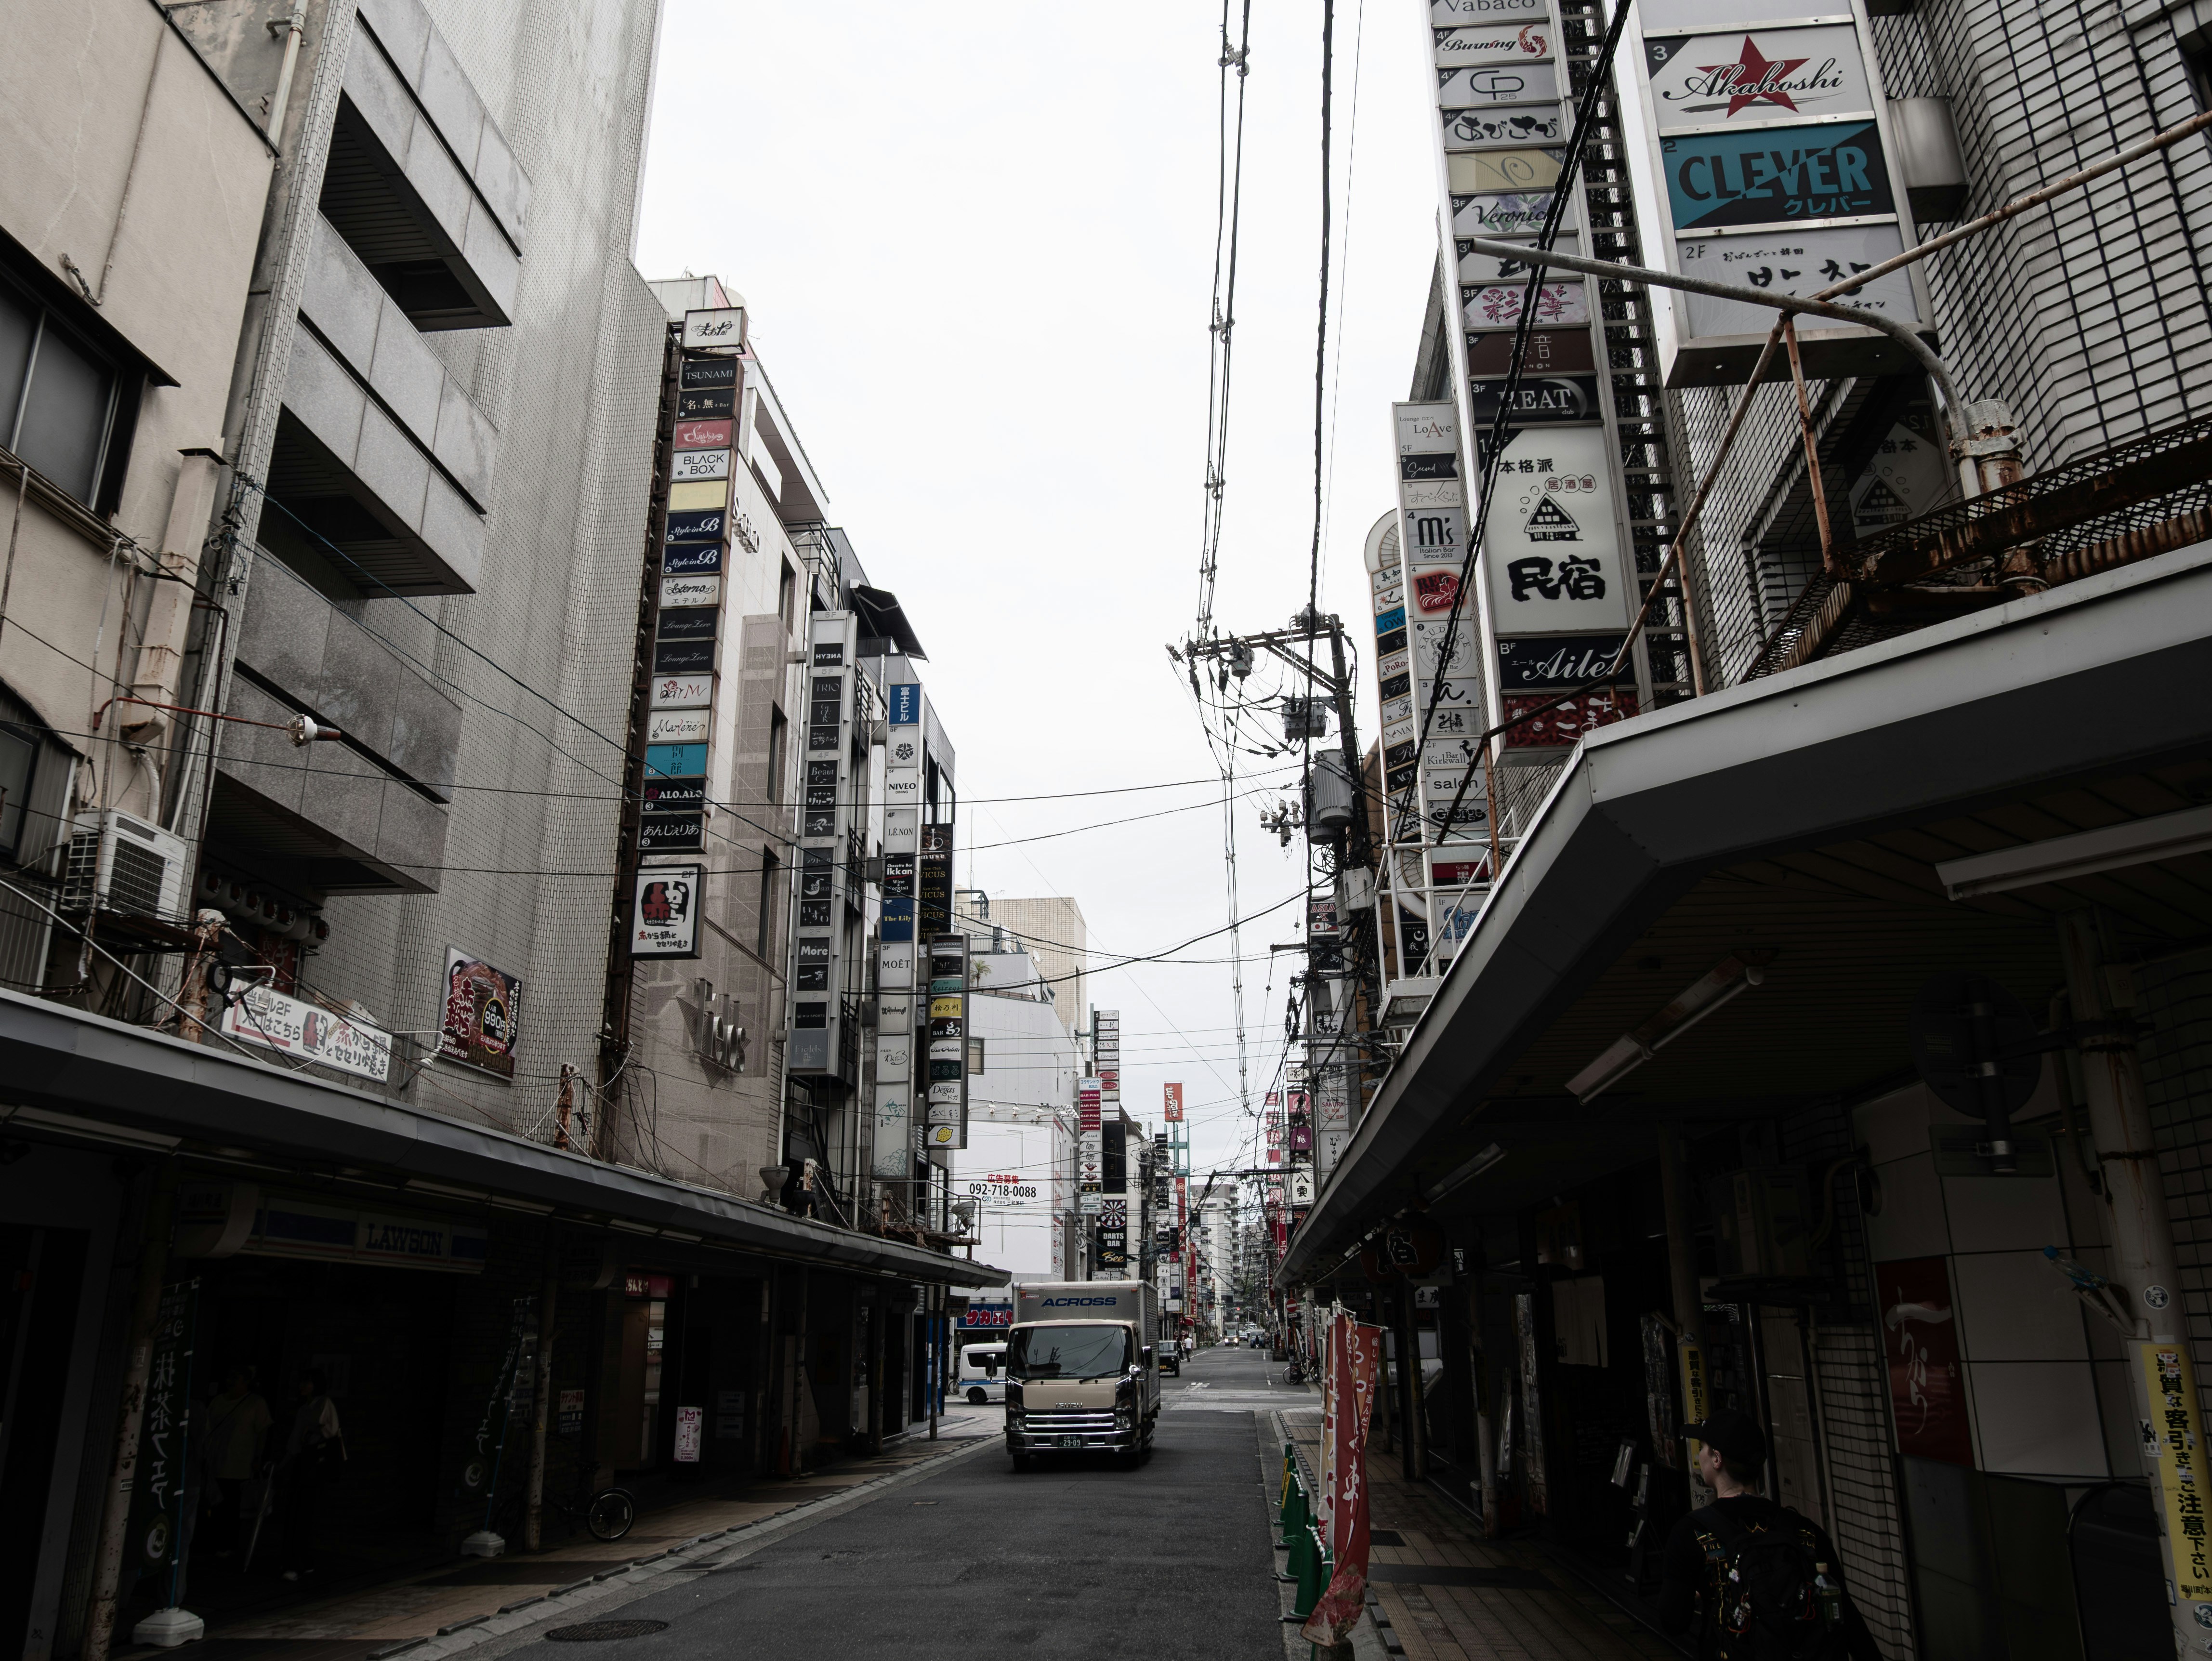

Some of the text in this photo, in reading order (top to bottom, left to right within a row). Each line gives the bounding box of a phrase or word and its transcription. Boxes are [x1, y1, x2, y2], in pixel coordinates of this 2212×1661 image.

[1437, 31, 1450, 40] 4F
[1442, 39, 1516, 52] Burning
[1441, 71, 1454, 79] 4F
[1662, 58, 1843, 100] Akahoshi
[1678, 146, 1873, 201] CLEVER
[1453, 199, 1466, 208] 3F
[1784, 198, 1871, 215] クレバー
[1472, 202, 1557, 224] Veronic
[1686, 245, 1706, 259] 2F
[685, 369, 734, 380] TSUNAMI
[1473, 384, 1486, 393] 3F
[683, 454, 724, 465] BLACK
[690, 464, 716, 475] BOX
[1407, 462, 1436, 477] Second
[1500, 459, 1554, 474] 本格派
[1547, 479, 1594, 490] 居酒屋
[672, 526, 691, 536] Style
[700, 517, 720, 532] B
[669, 559, 688, 567] Style
[698, 549, 718, 564] B
[1507, 554, 1606, 602] 民宿
[1382, 611, 1398, 620] Lounge
[663, 620, 711, 631] Lounge Zero
[1500, 643, 1516, 654] BF
[660, 653, 709, 664] Lounge Zero
[815, 683, 840, 692] TRIO
[899, 686, 910, 722] 富士ビル
[1427, 753, 1466, 765] Kirkwall
[811, 766, 835, 776] Beaut
[658, 790, 703, 800] ALO.ALO
[644, 824, 699, 837] あんじぇりあ
[681, 870, 695, 879] 2F
[887, 868, 913, 876] Ikkan
[1311, 903, 1336, 913] ASIA
[801, 946, 829, 956] More
[882, 960, 911, 969] MOËT
[242, 1013, 301, 1041] 入口はこちら
[484, 1011, 506, 1032] 990円
[336, 1022, 388, 1056] 赤から鍋
[933, 1084, 955, 1096] Degas
[988, 1174, 1019, 1185] 広告募集
[969, 1183, 1037, 1198] 092-718-0088
[1295, 1173, 1310, 1198] 八雲
[366, 1223, 443, 1255] LAWSON
[1102, 1251, 1125, 1263] Bee
[1040, 1297, 1117, 1307] ACROSS
